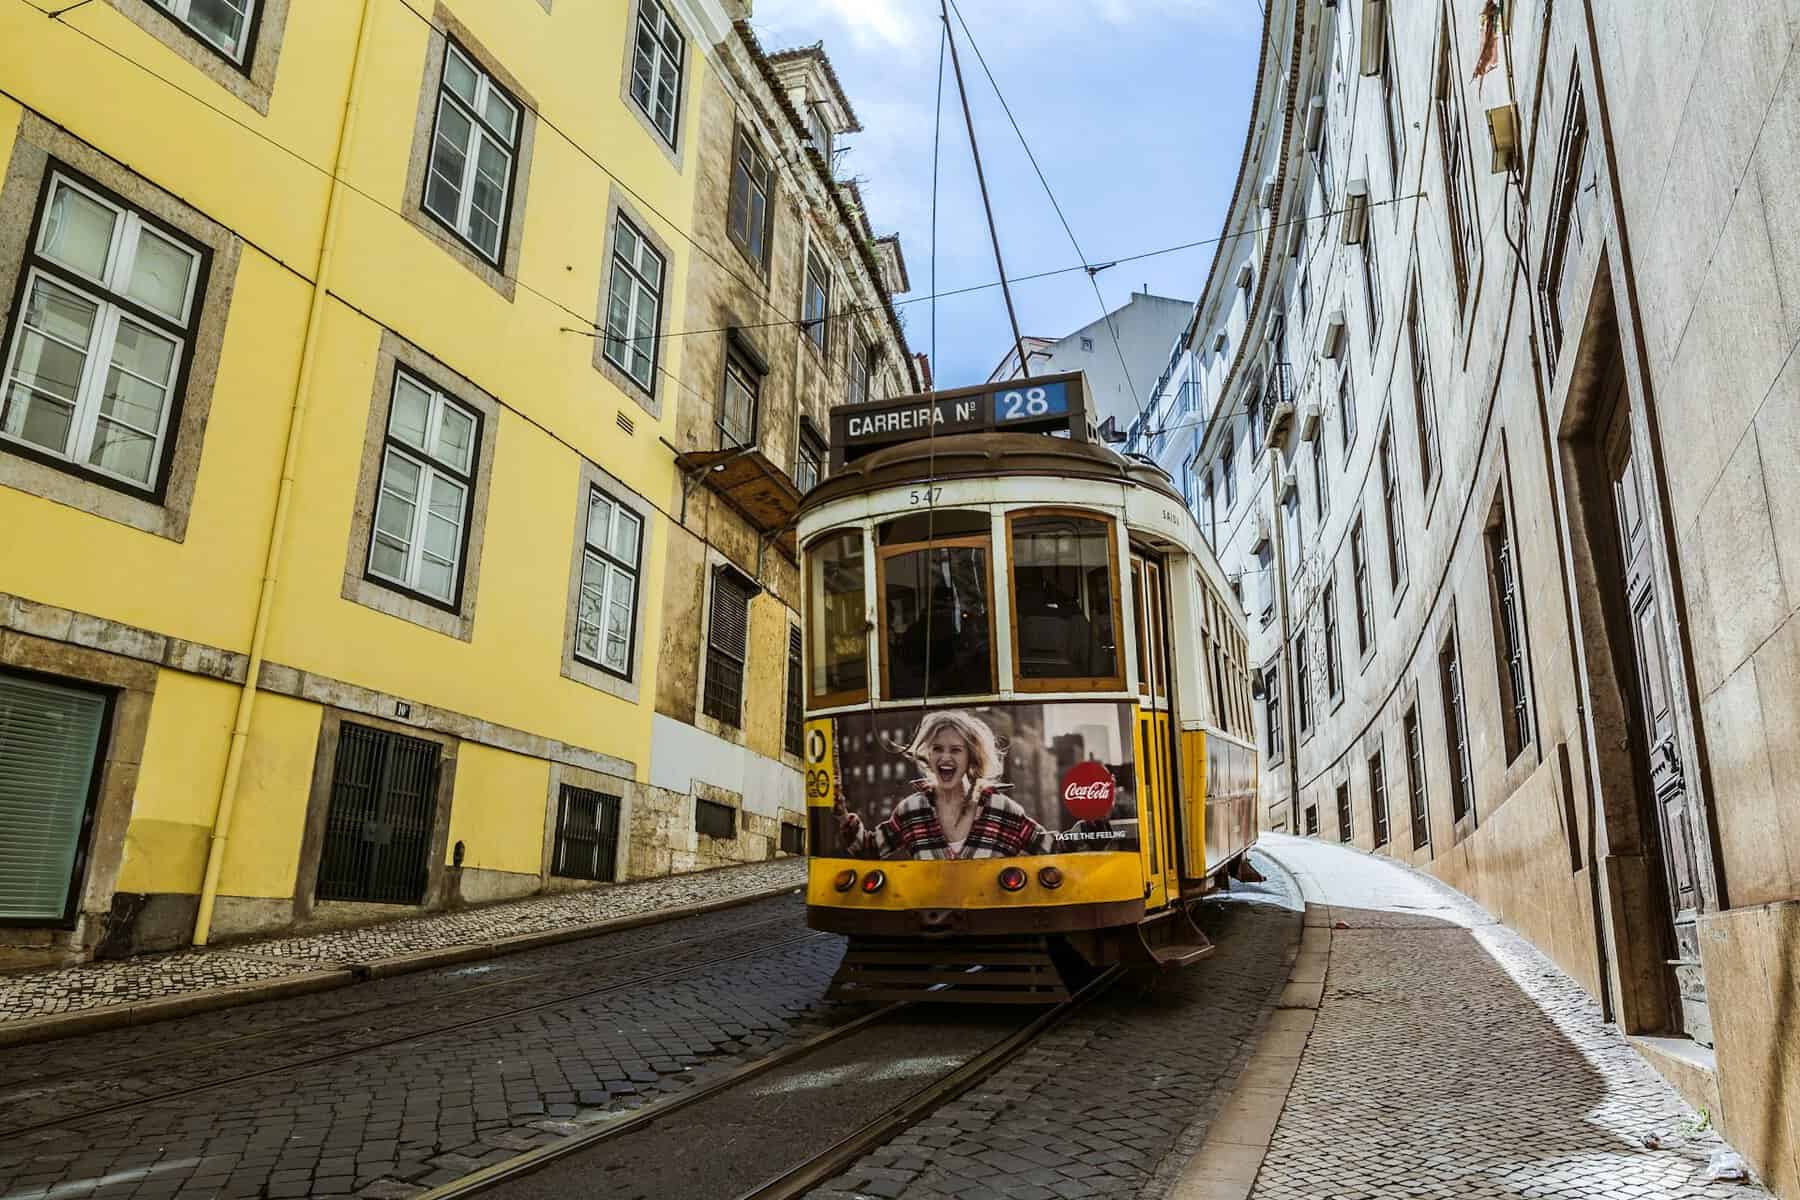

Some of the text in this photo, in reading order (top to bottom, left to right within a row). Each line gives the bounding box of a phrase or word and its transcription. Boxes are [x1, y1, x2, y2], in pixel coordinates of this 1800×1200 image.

[849, 407, 945, 437] CARREIRA
[1003, 387, 1049, 420] 28
[910, 487, 943, 505] 547
[1064, 781, 1112, 801] Coca-Cola
[1055, 830, 1126, 841] TASTE THE FEELING
